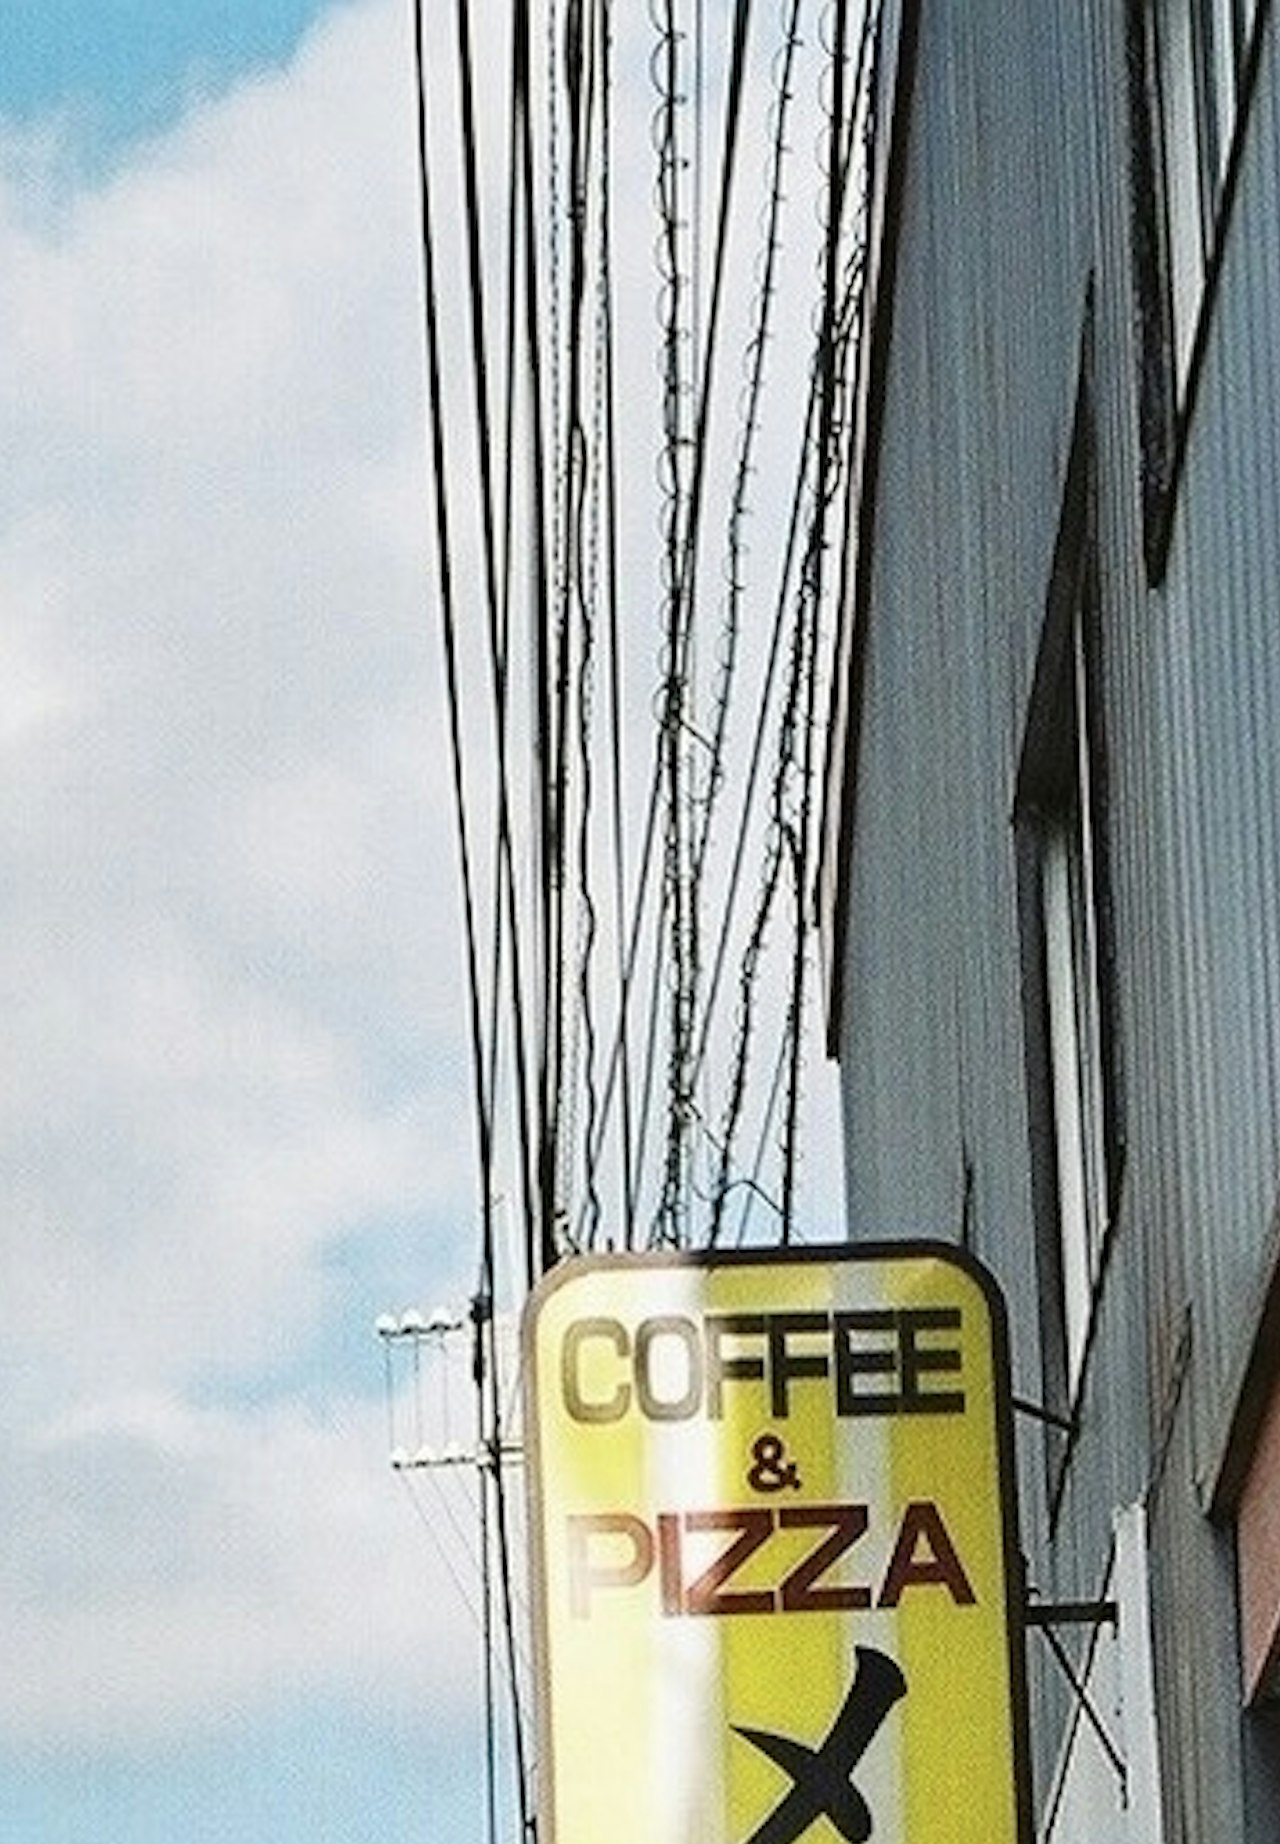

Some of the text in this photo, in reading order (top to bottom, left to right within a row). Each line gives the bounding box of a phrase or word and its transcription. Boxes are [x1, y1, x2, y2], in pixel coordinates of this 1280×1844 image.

[560, 1308, 967, 1425] COFFEE
[746, 1434, 801, 1493] &
[567, 1500, 977, 1620] PIZZA
